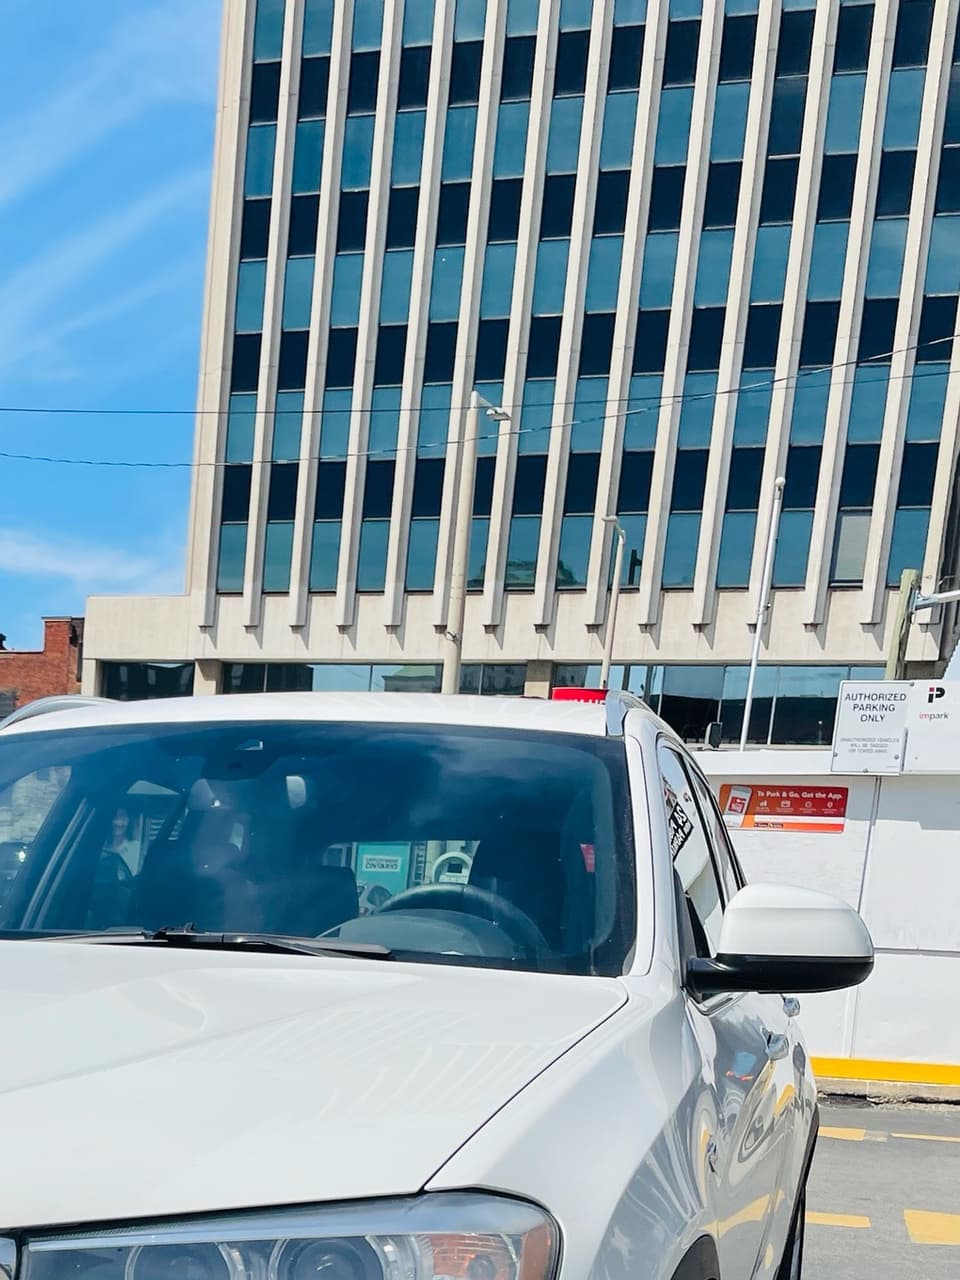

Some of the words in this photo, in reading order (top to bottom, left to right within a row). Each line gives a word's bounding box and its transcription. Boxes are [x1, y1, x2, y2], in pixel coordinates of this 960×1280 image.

[845, 692, 908, 702] AUTHORIZED
[852, 703, 896, 712] PARKING
[860, 713, 886, 723] ONLY
[918, 712, 950, 721] impark
[766, 790, 780, 798] Park
[801, 791, 814, 799] Get
[815, 791, 827, 799] the
